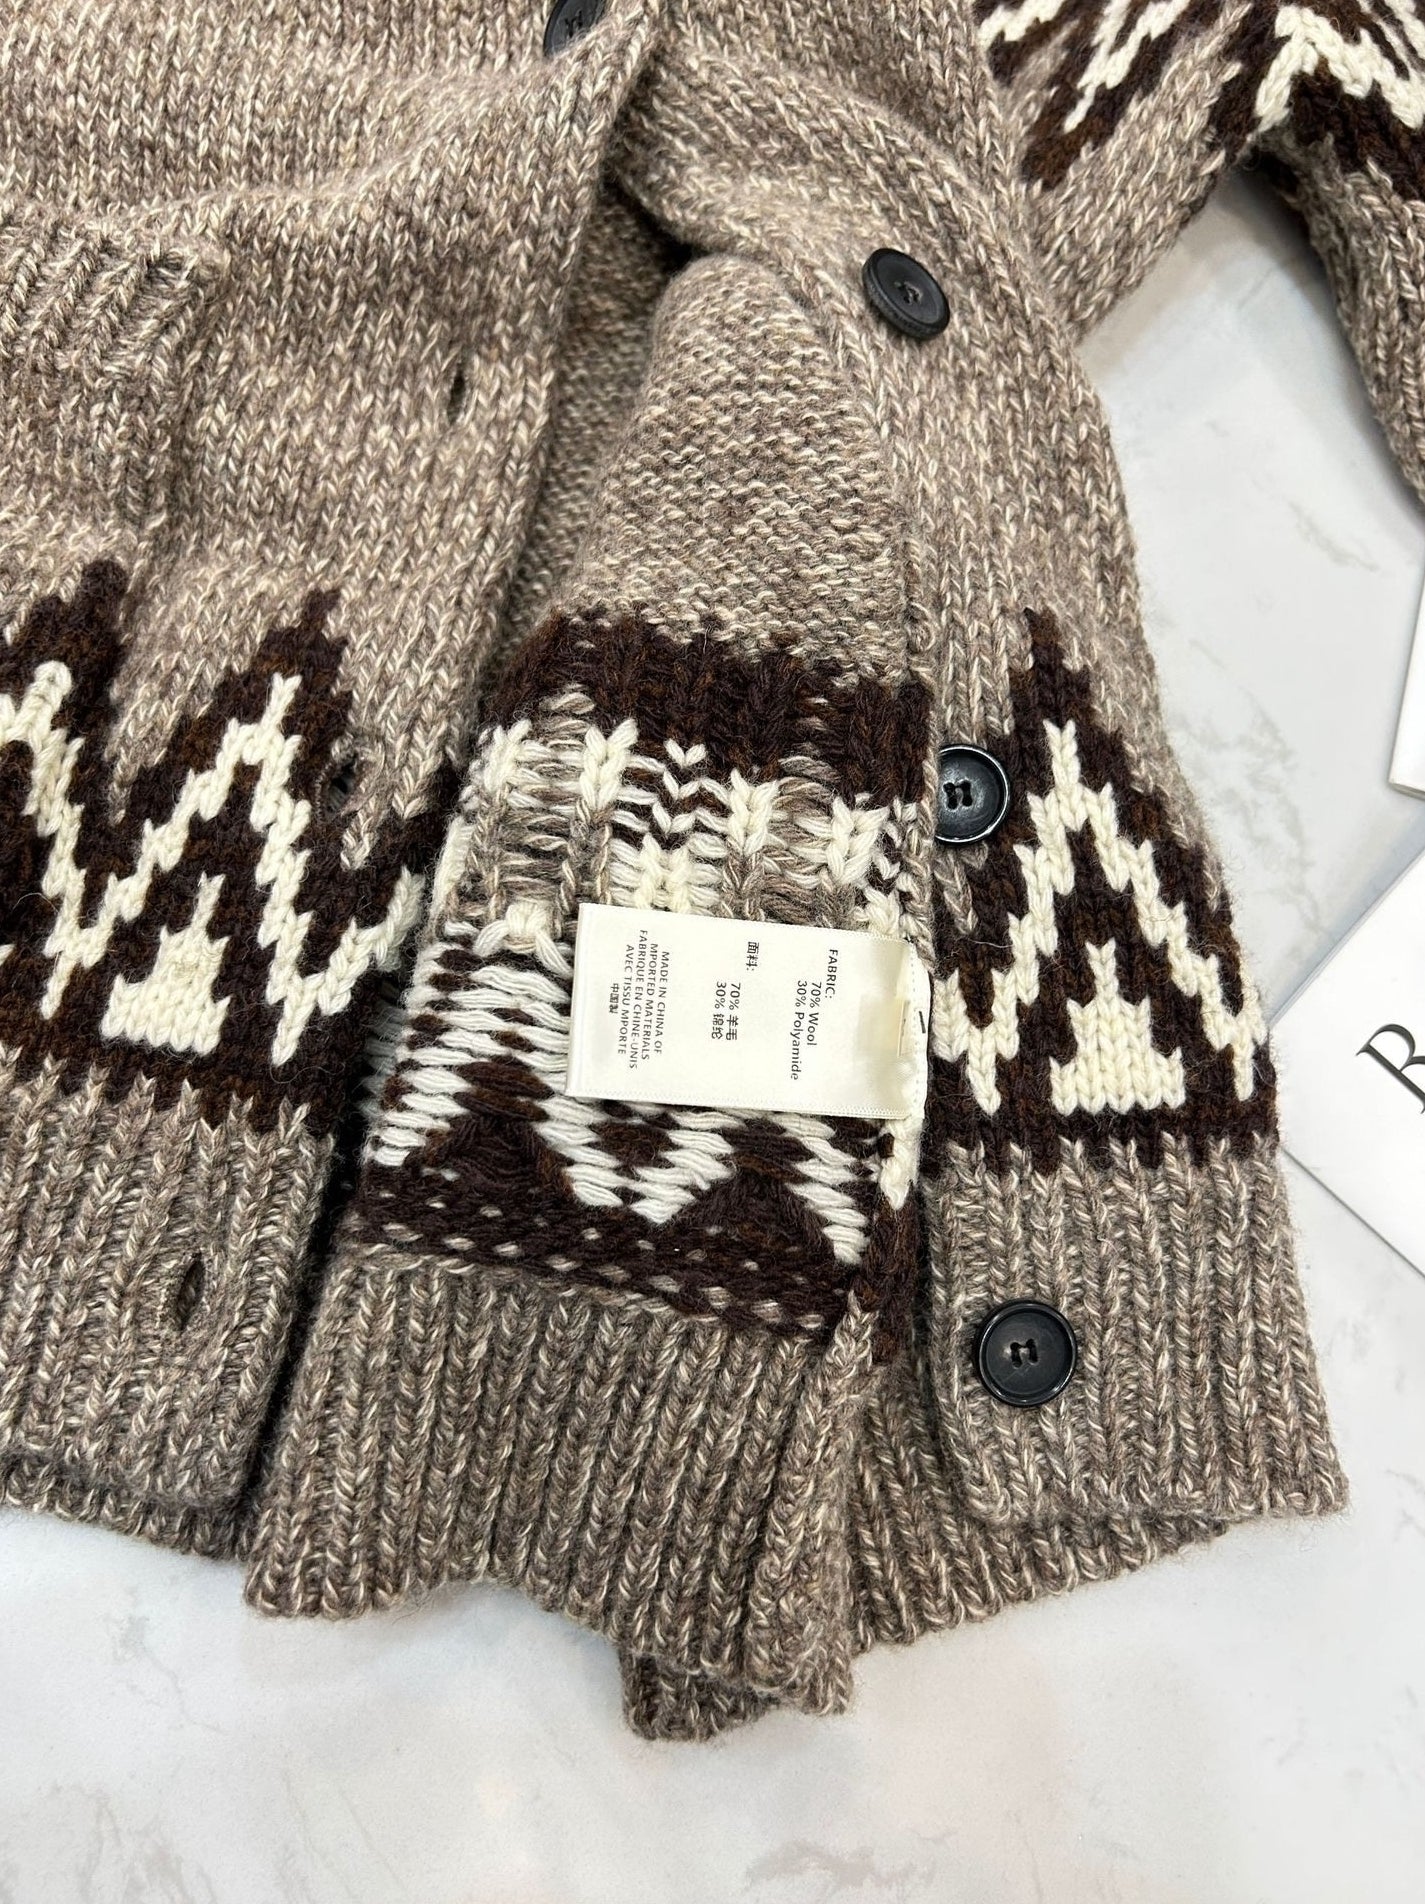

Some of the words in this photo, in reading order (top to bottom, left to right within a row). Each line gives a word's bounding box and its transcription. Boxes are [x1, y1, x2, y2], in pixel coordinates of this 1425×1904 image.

[624, 944, 634, 972] AVEC
[635, 929, 648, 982] FABRIQUE
[659, 951, 670, 982] MADE
[825, 949, 838, 998] FABRIC:
[622, 977, 632, 1005] TISSU
[635, 986, 643, 1001] EN
[658, 986, 667, 998] IN
[715, 981, 727, 1009] 30%
[729, 982, 741, 1010] 70%
[795, 980, 808, 1007] 30%
[809, 982, 822, 1008] 70%
[641, 999, 653, 1060] MATERIALS
[655, 1002, 665, 1037] CHINA
[726, 1014, 738, 1040] 羊毛
[807, 1012, 819, 1045] Wool
[629, 1004, 642, 1069] CHINE-UNIS
[654, 1040, 662, 1054] OF
[790, 1012, 805, 1080] Polyamide
